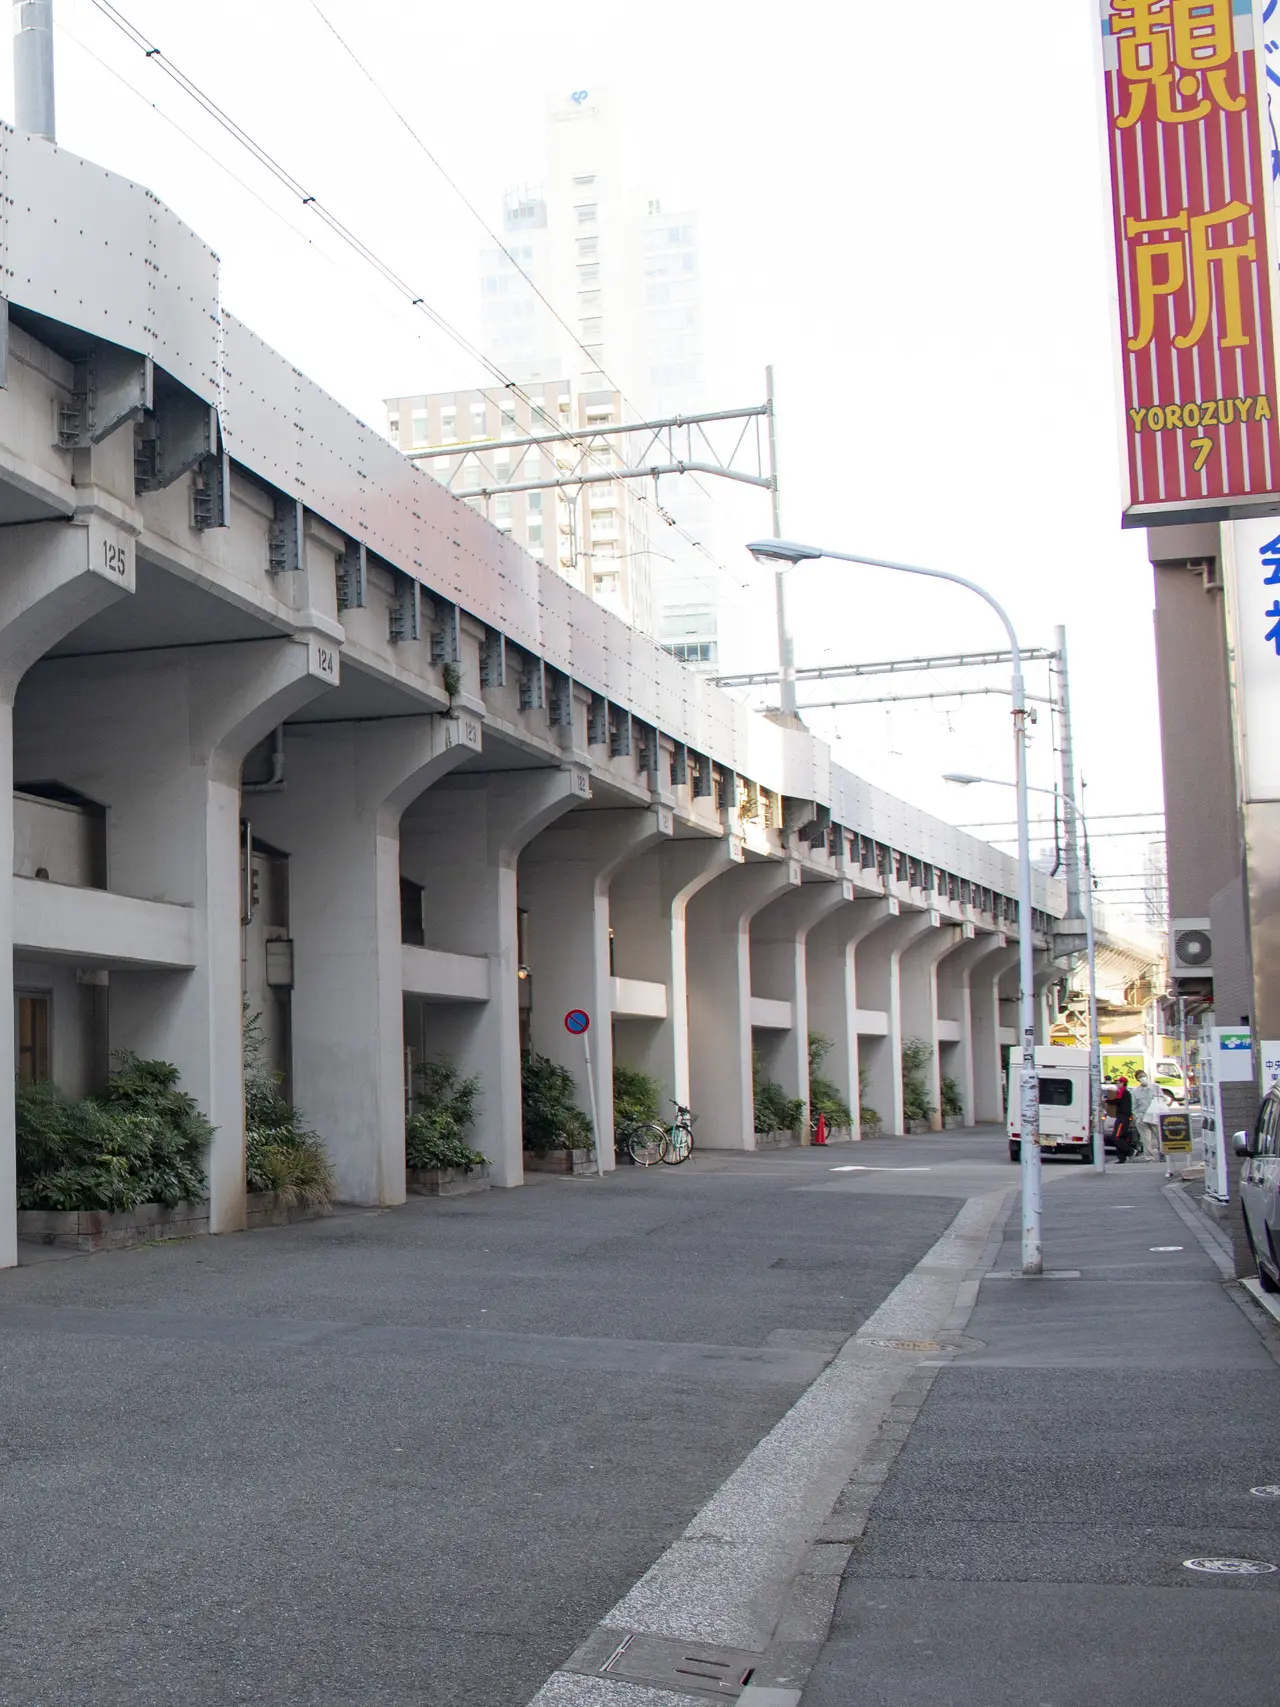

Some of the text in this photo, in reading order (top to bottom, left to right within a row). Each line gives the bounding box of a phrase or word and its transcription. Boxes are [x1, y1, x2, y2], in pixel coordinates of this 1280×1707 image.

[1128, 394, 1273, 433] YOROZUYA
[1189, 435, 1213, 472] 7
[103, 540, 125, 576] 125
[318, 647, 333, 674] 124
